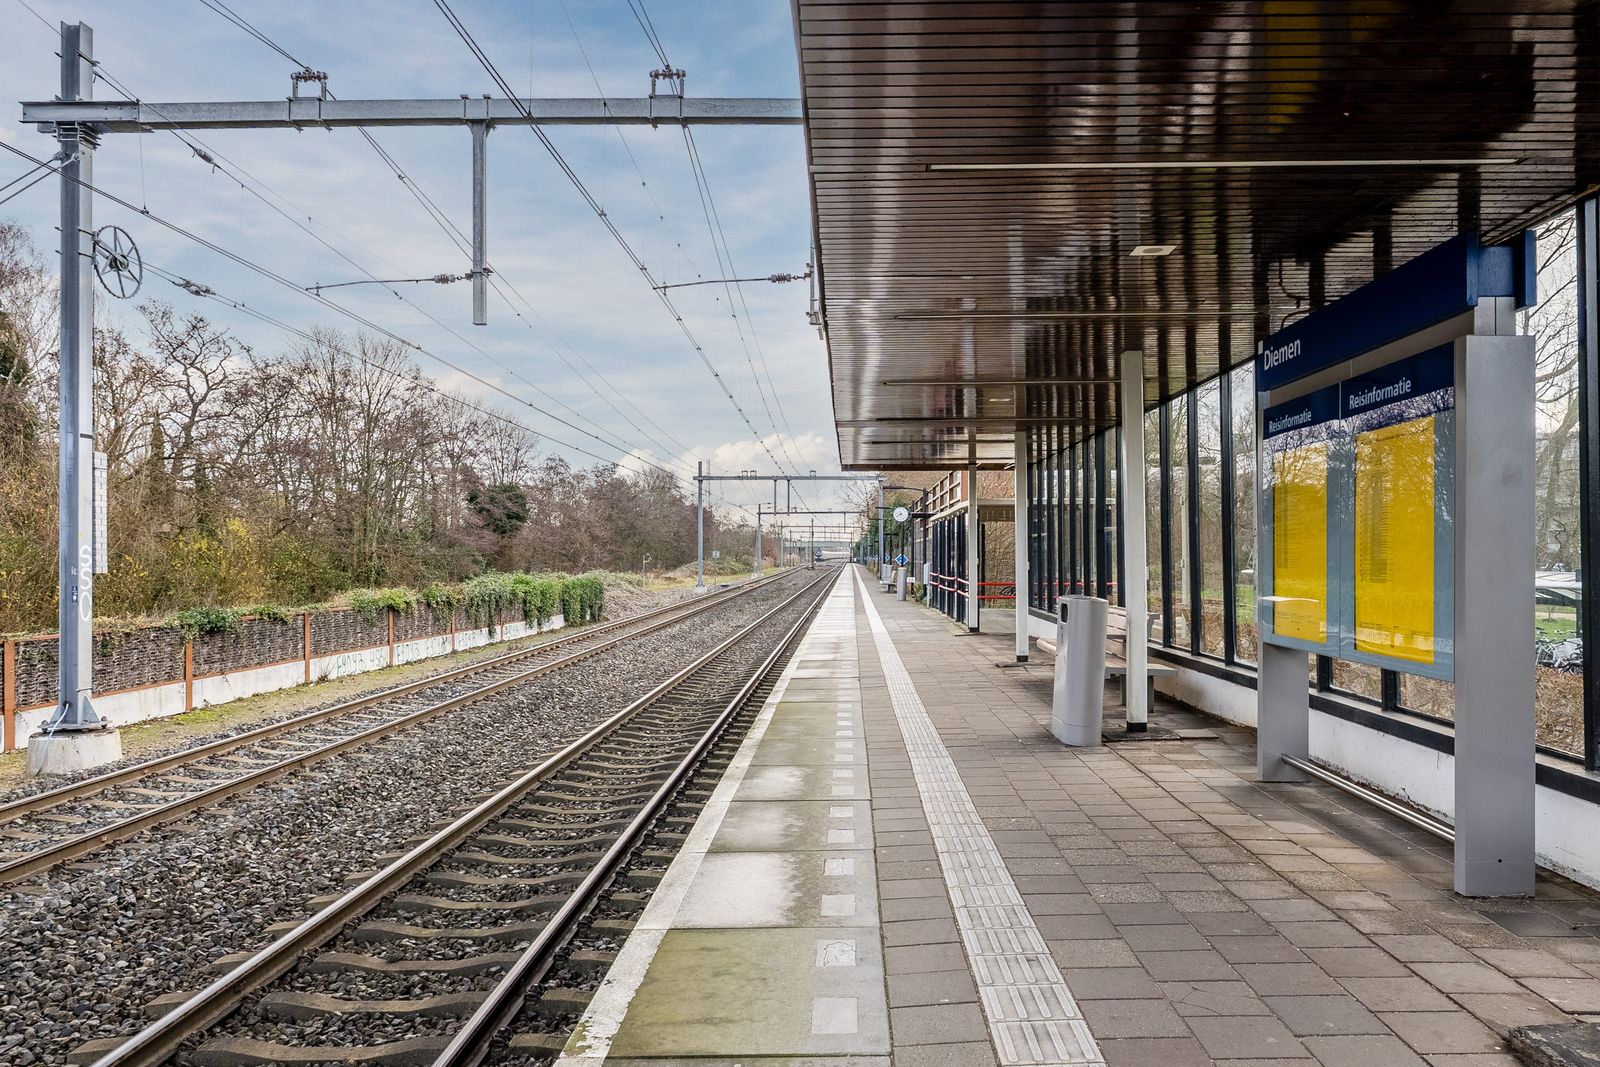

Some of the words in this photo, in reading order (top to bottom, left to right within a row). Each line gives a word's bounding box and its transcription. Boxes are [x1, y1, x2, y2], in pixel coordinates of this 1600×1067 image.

[1264, 339, 1301, 371] Diemen
[1349, 377, 1412, 410] Reisinformatie
[1268, 408, 1312, 433] Reisinformatie
